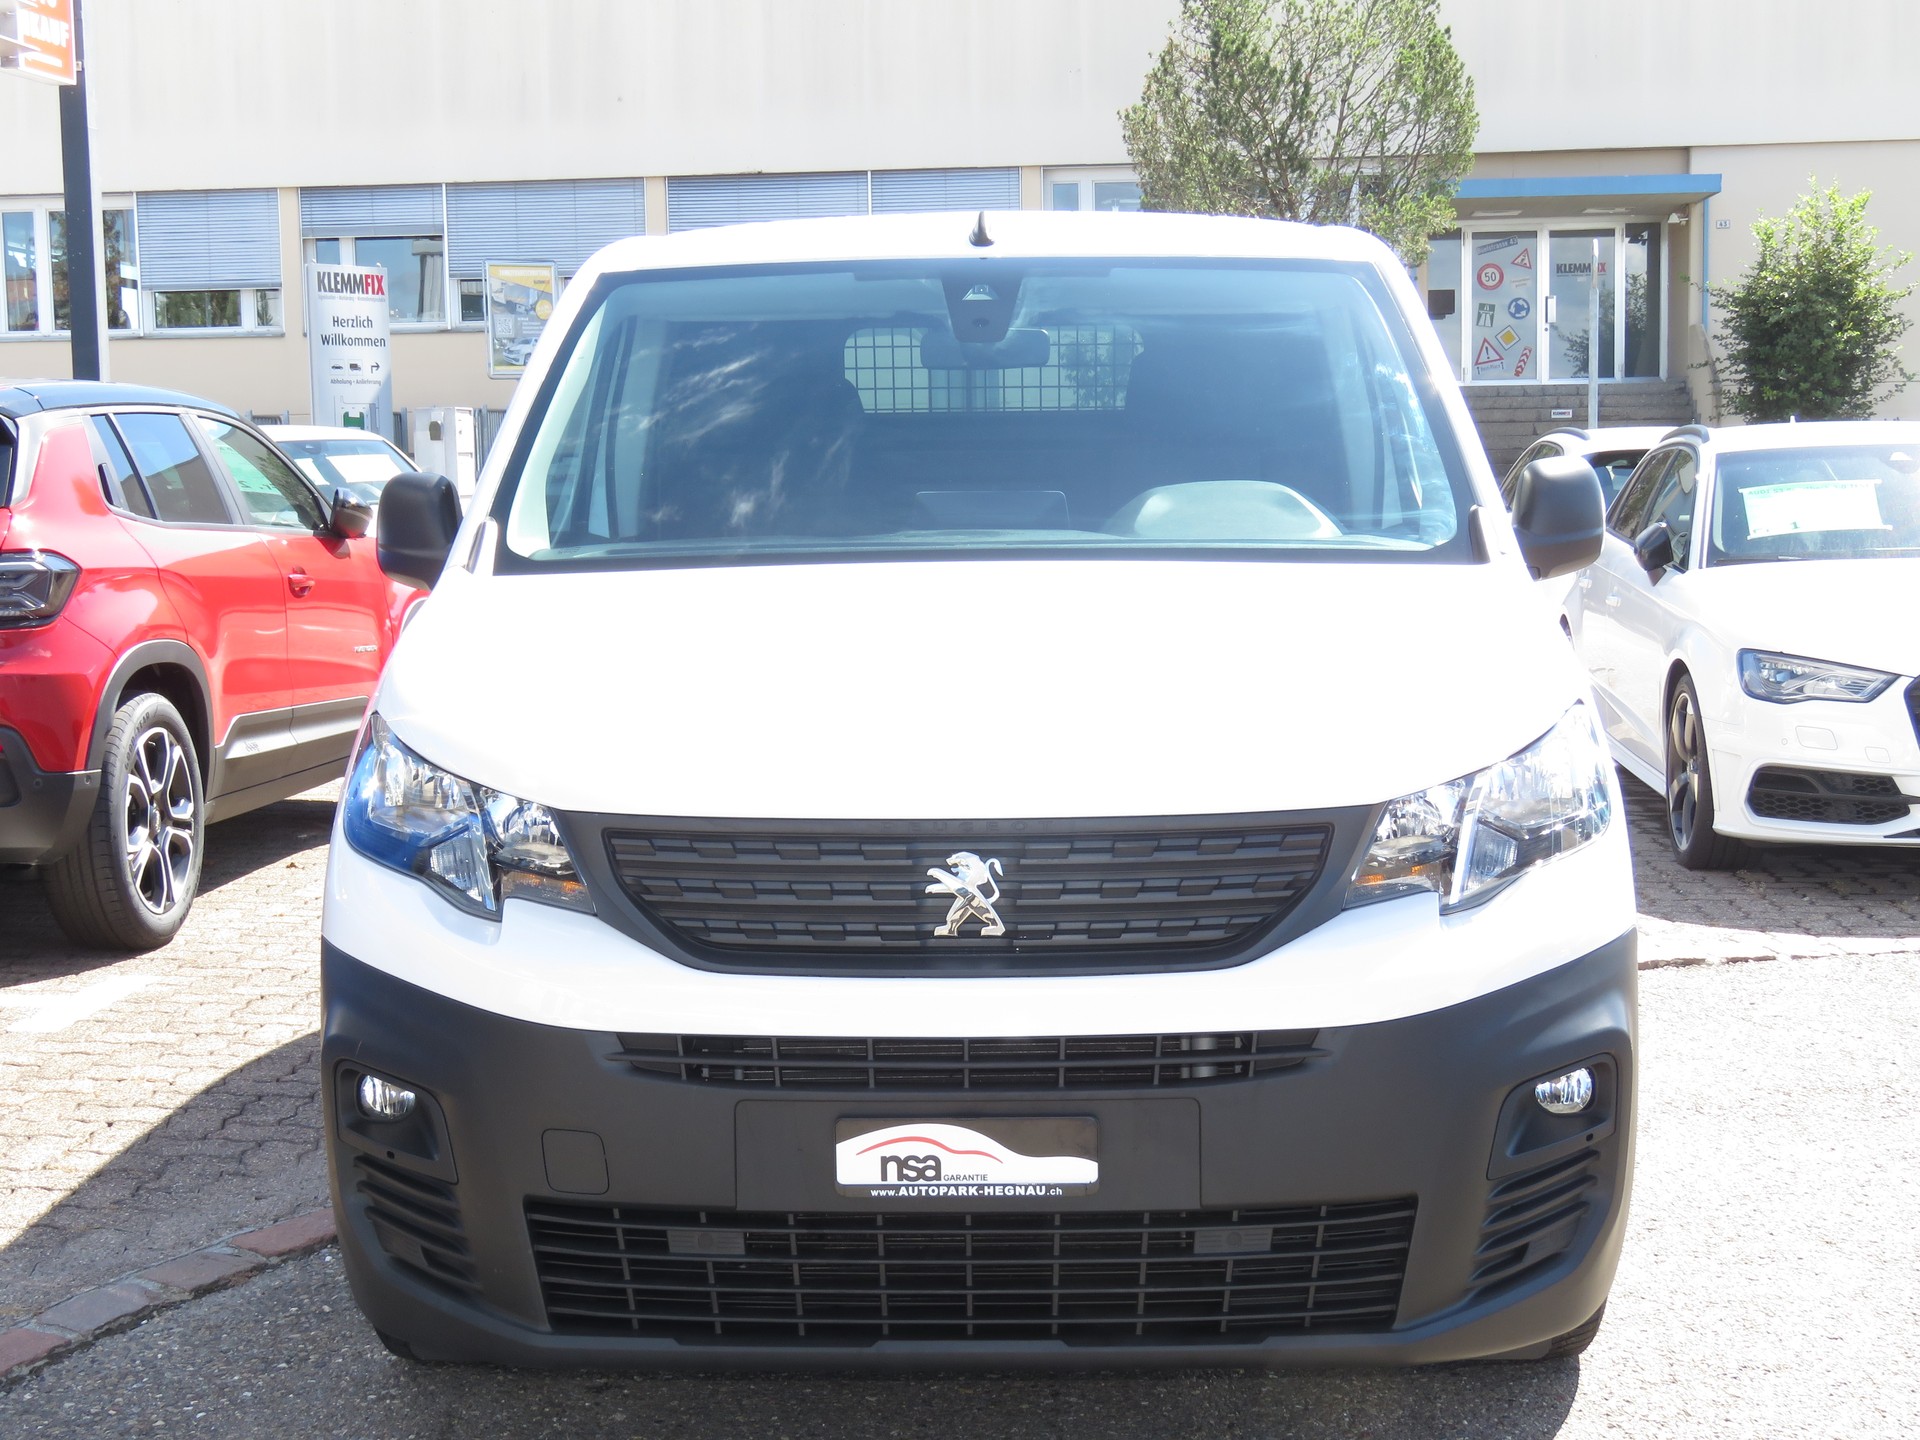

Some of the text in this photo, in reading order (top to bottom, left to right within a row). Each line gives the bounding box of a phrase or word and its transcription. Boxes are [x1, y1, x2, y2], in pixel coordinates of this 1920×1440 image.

[1556, 262, 1607, 274] KLEMMIX
[317, 271, 385, 296] KLEMMFIX
[1484, 271, 1497, 283] 50
[332, 315, 373, 329] Herzlich
[320, 333, 386, 347] Willkommen
[880, 820, 1053, 833] PEUGEOT
[880, 1155, 942, 1182] nsa
[943, 1173, 989, 1182] GARANTIE
[870, 1185, 1063, 1197] www.AUTOPARK-HEGNAU.ch
